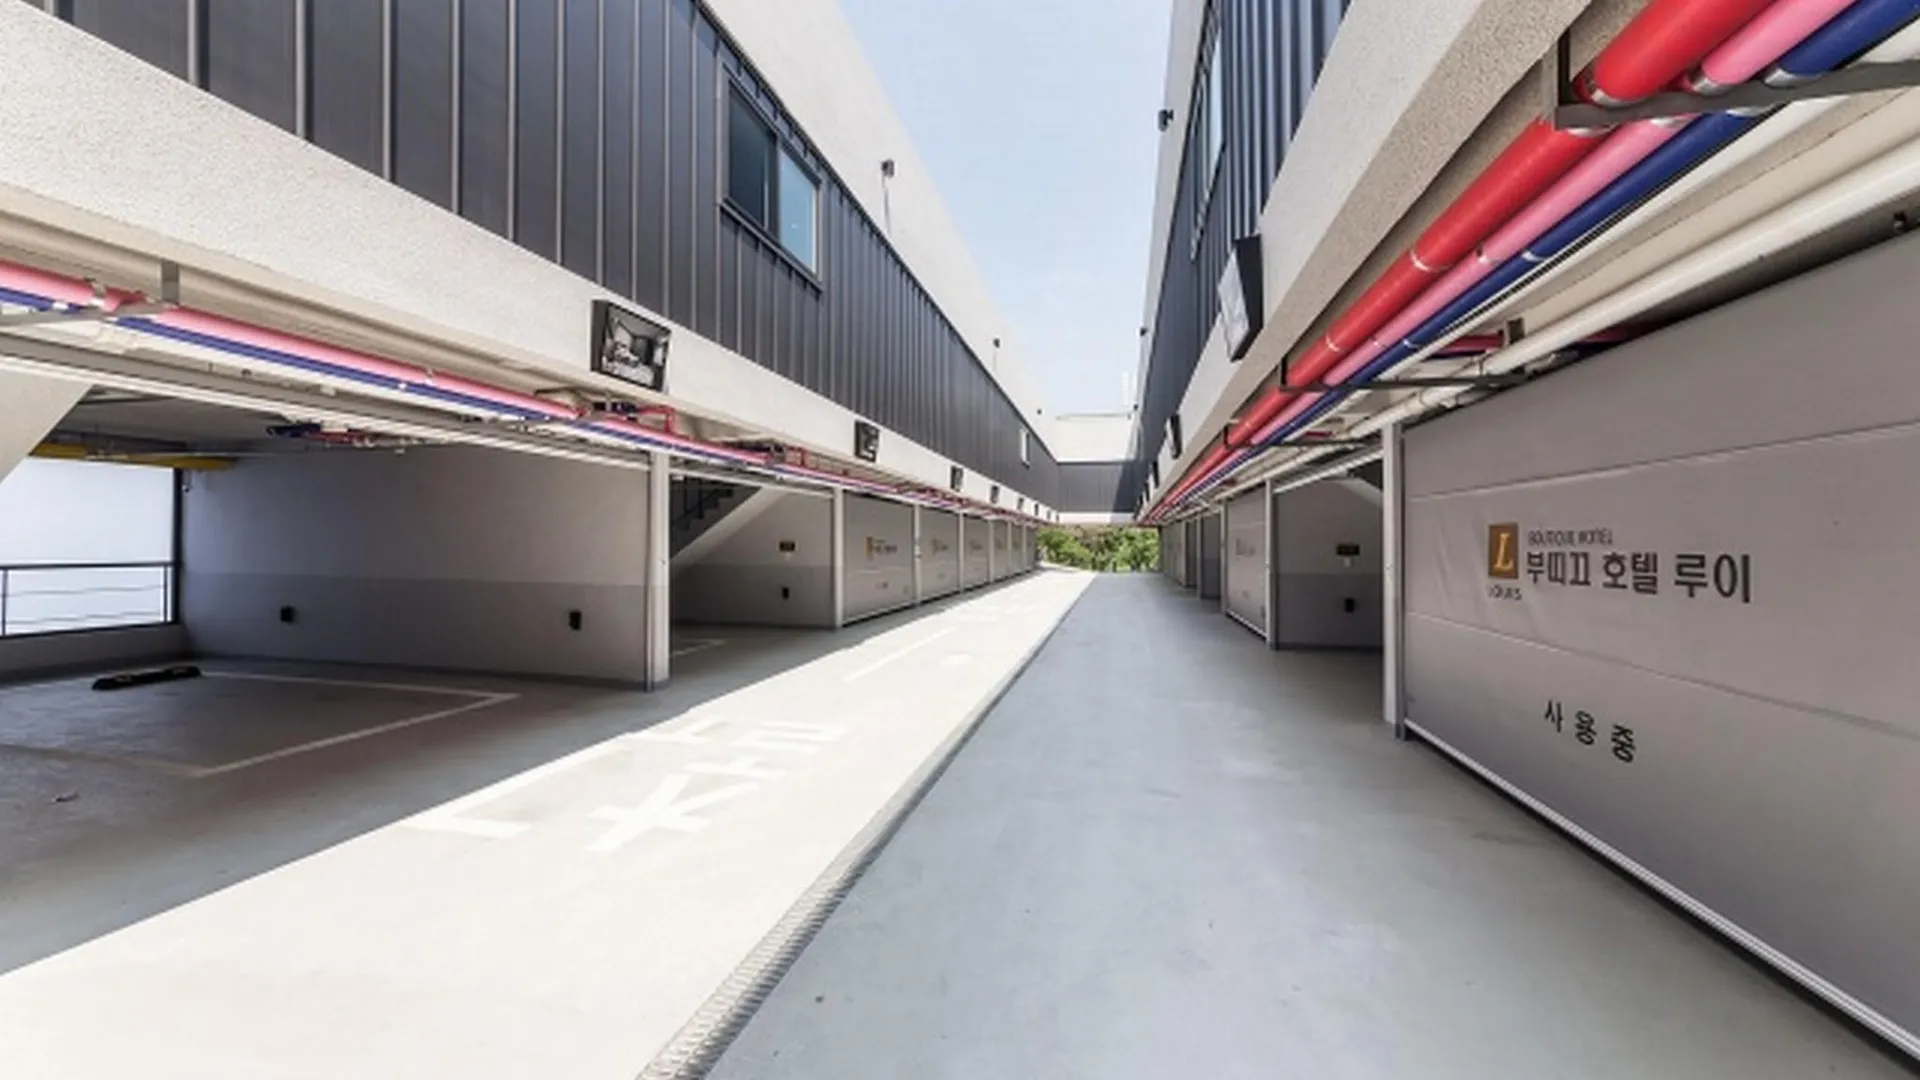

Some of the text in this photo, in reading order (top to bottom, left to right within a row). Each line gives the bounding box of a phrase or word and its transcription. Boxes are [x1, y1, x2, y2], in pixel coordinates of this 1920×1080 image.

[1526, 551, 1751, 604] 부띠끄 호텔 루이
